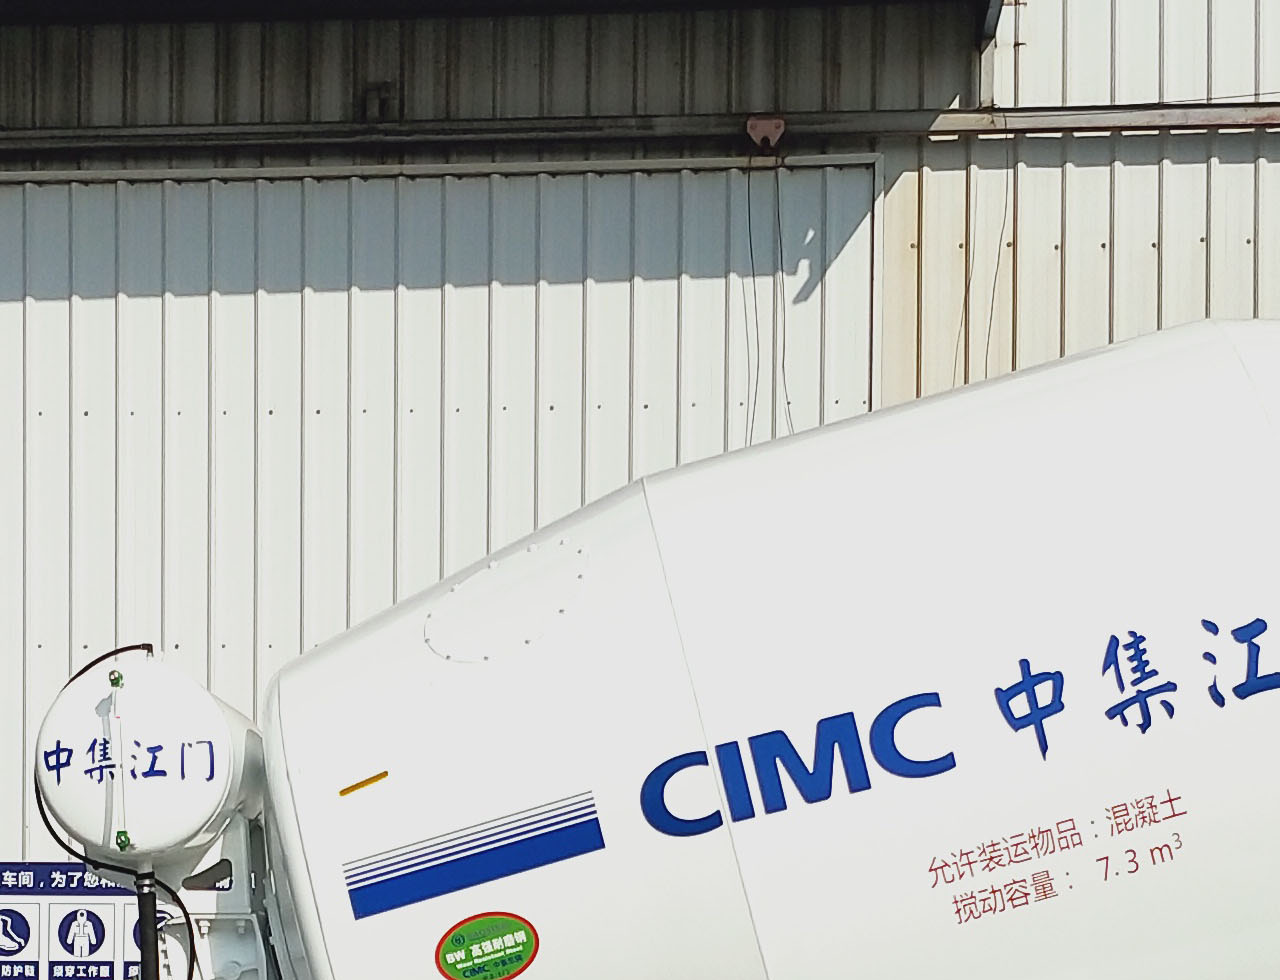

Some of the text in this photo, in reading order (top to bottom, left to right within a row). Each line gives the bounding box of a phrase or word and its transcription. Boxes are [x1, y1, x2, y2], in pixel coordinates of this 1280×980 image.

[43, 737, 215, 786] 中集江门
[639, 692, 956, 837] CIMC
